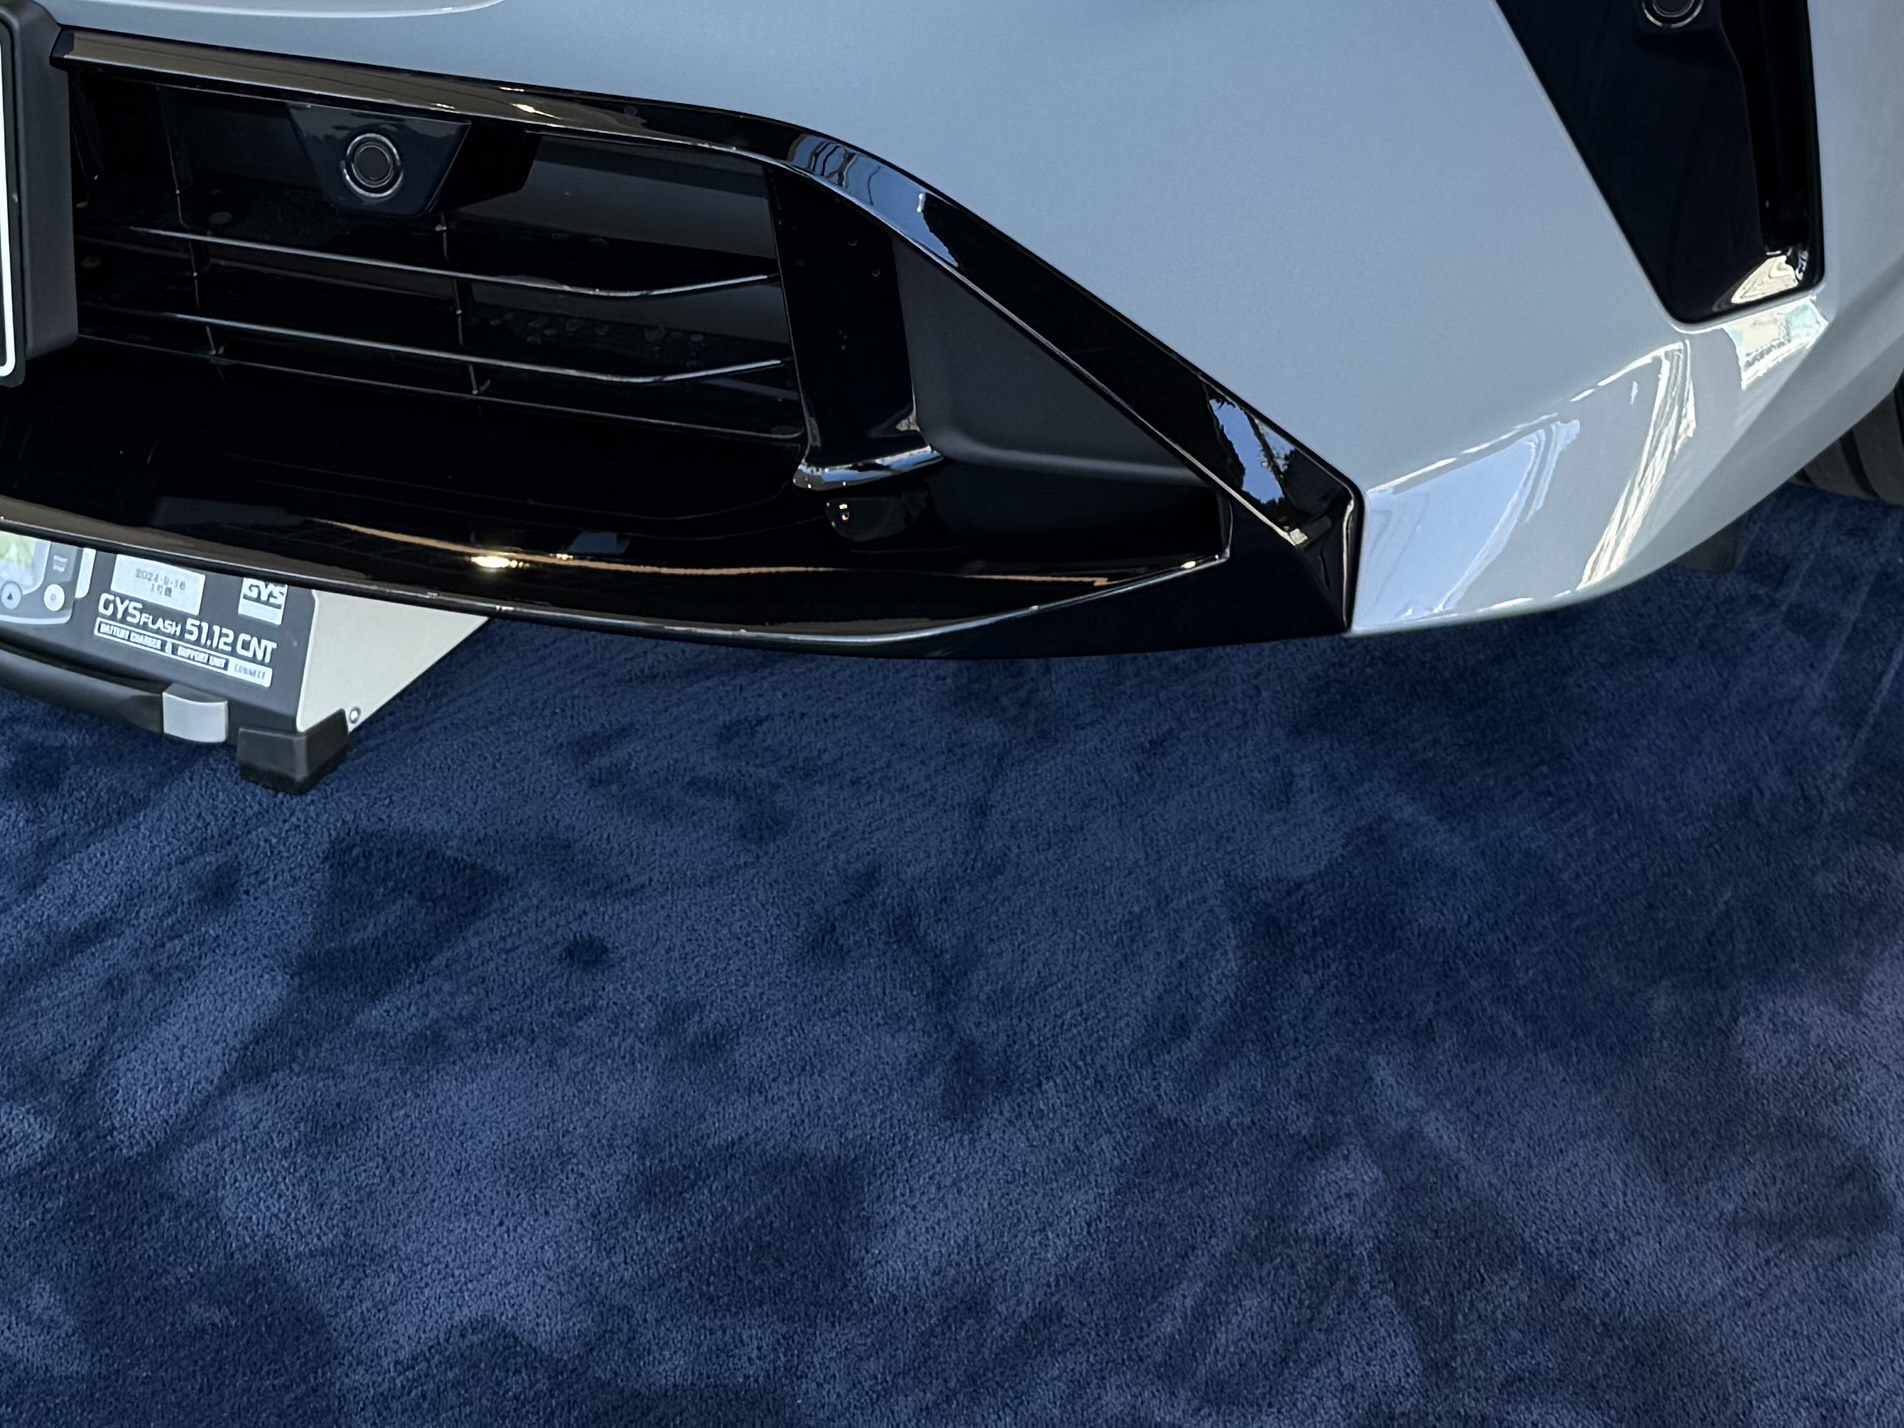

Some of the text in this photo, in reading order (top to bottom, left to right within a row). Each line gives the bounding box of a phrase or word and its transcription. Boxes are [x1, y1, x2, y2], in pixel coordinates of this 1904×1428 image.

[246, 578, 286, 606] GYS
[184, 617, 235, 652] 51.12
[236, 632, 278, 664] CNT
